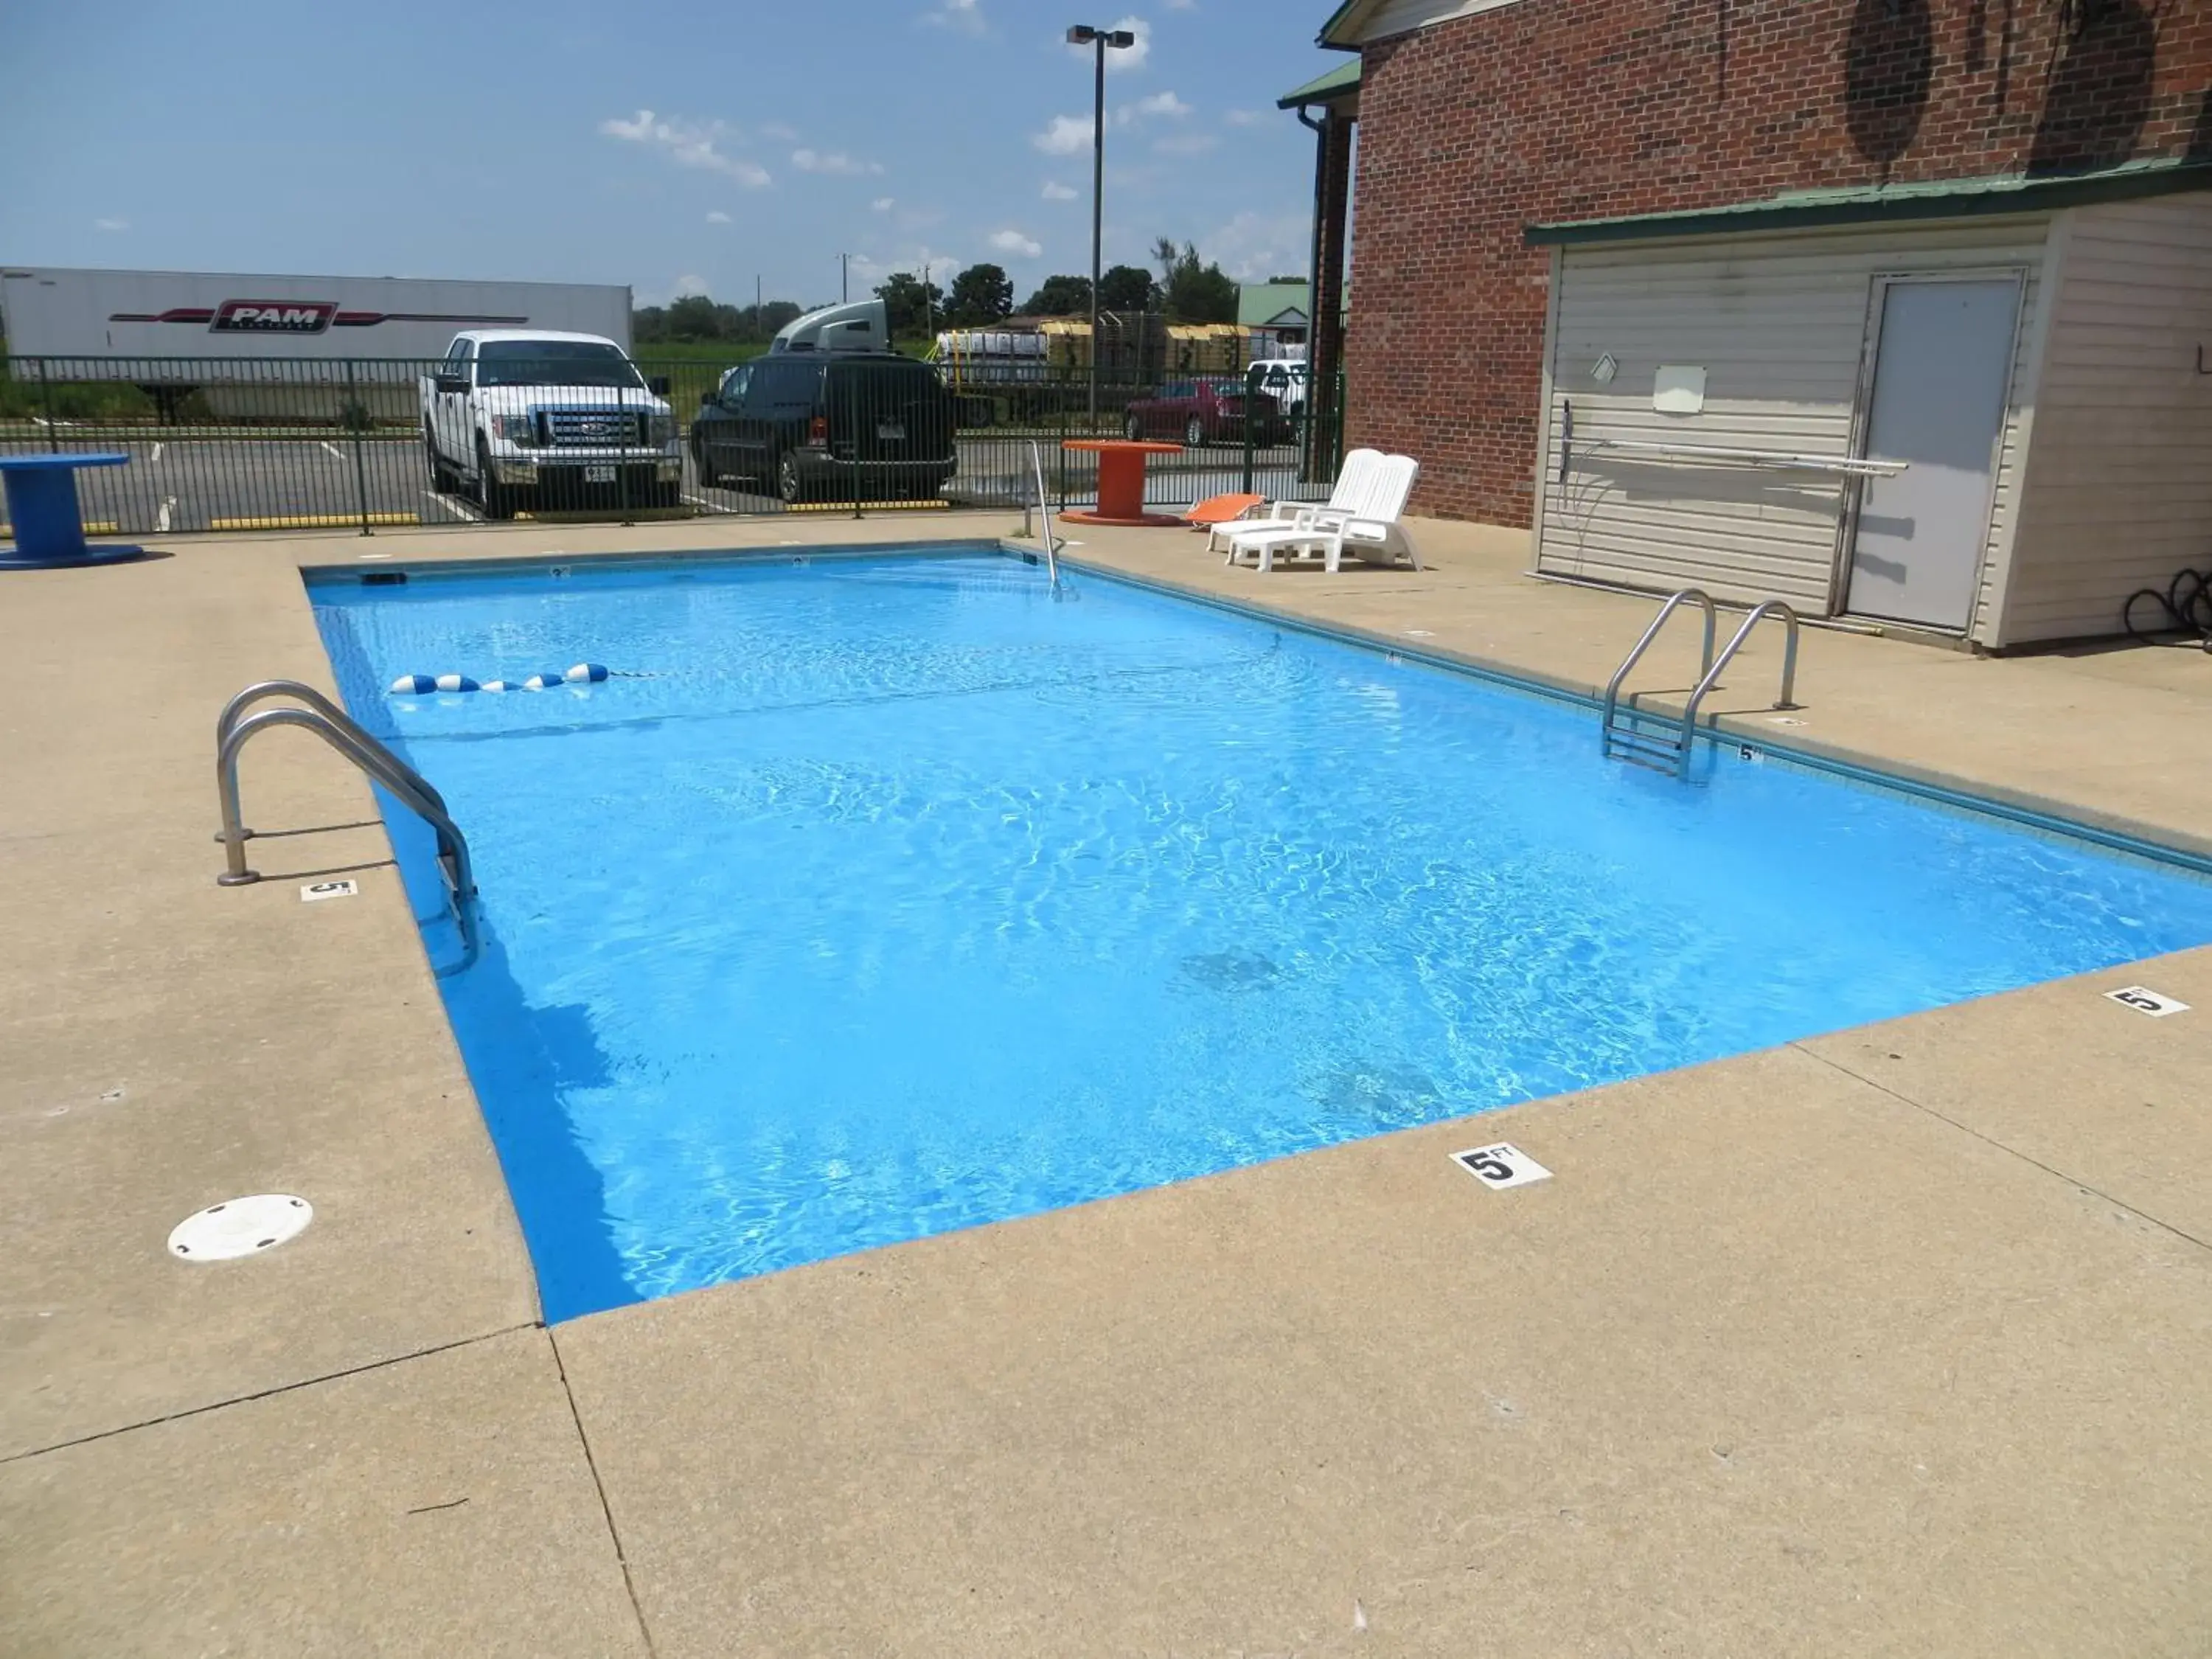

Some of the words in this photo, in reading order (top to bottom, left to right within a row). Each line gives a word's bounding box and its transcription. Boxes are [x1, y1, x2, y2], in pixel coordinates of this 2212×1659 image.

[232, 307, 319, 323] PAM
[1741, 743, 1752, 760] 5
[310, 882, 349, 892] 5
[2114, 992, 2162, 1010] 5
[1461, 1152, 1514, 1180] 5
[1489, 1147, 1514, 1159] FT
